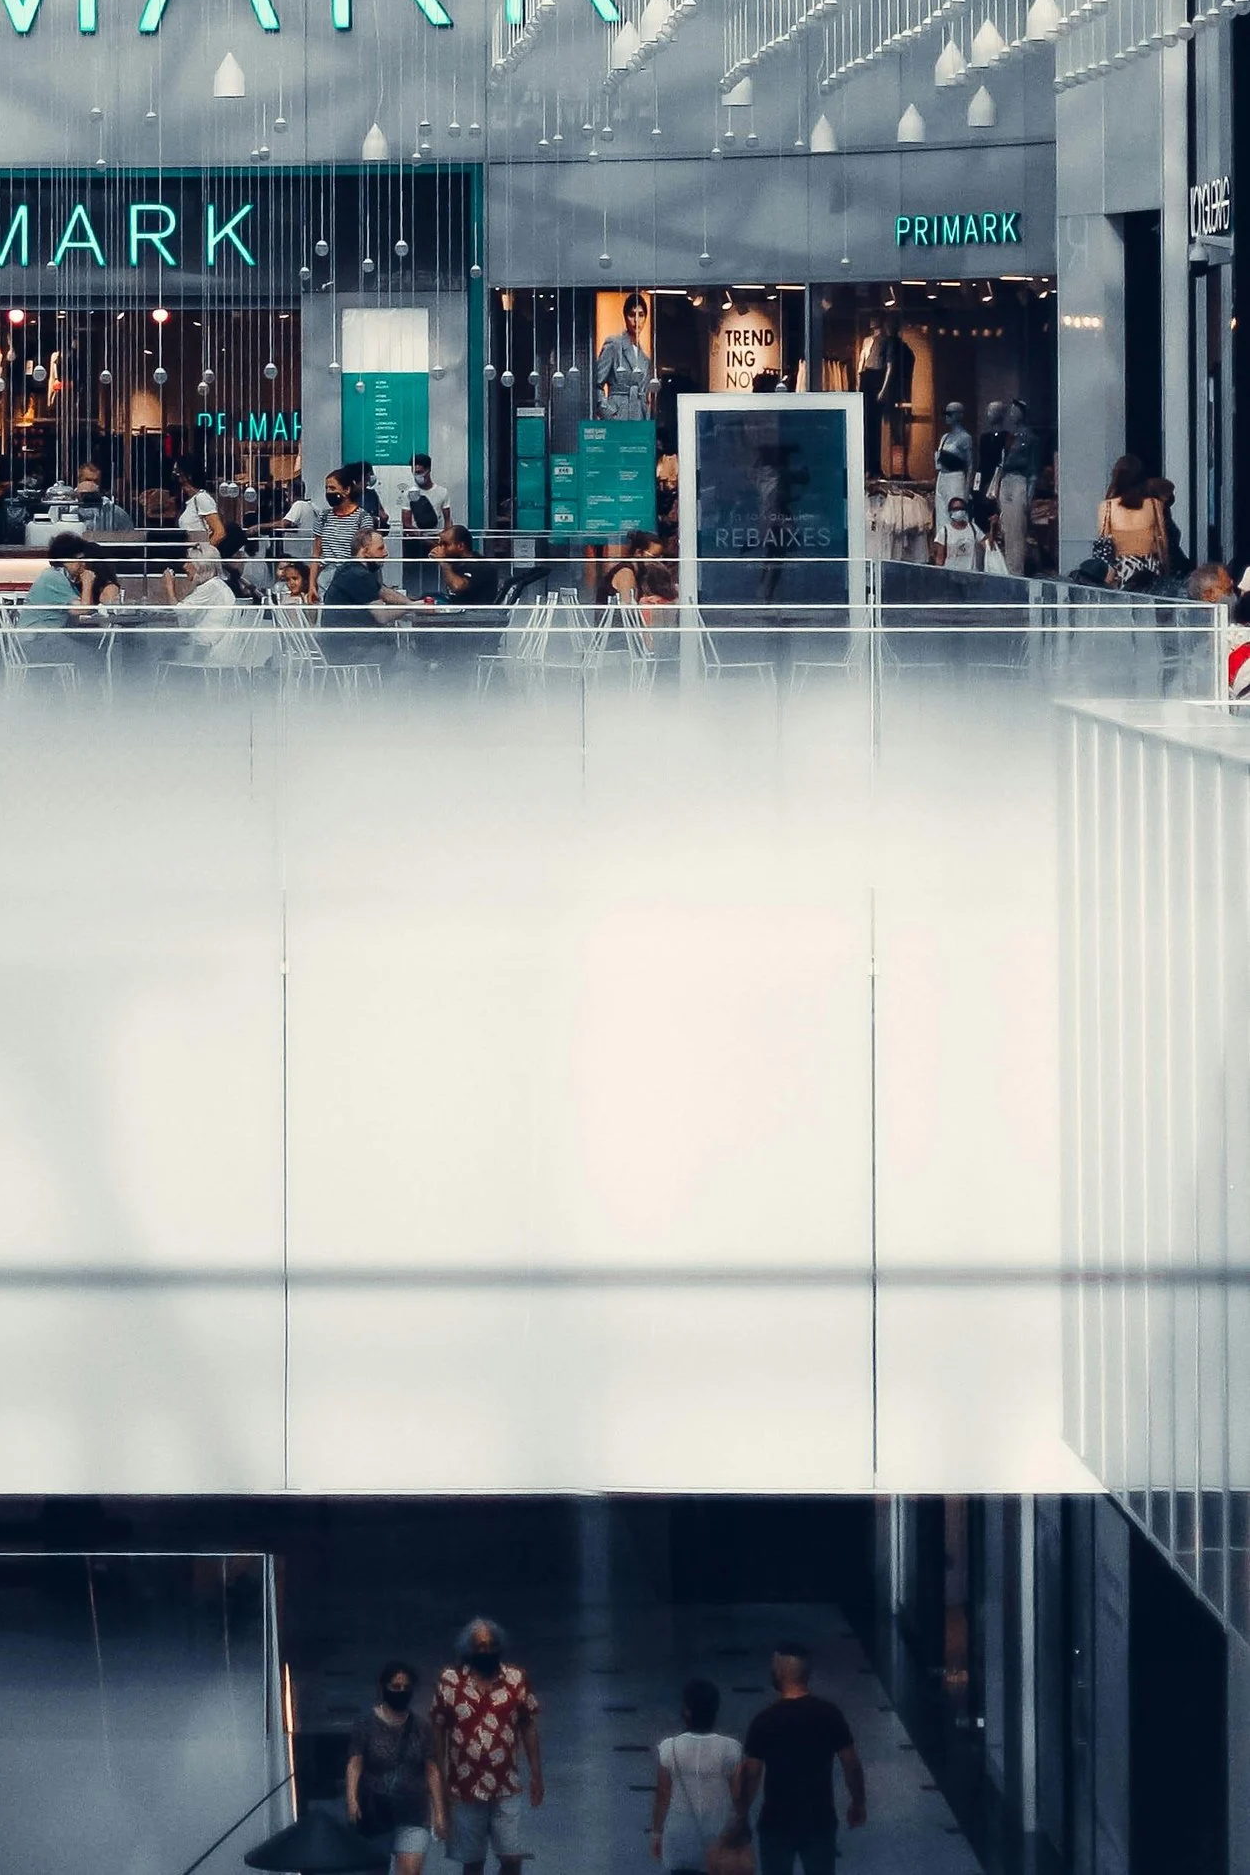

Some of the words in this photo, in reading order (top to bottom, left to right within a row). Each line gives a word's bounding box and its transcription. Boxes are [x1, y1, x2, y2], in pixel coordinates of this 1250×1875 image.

[896, 211, 1018, 245] PRIMARK
[725, 329, 774, 346] TREND
[726, 350, 756, 367] ING
[726, 371, 754, 389] NO
[715, 527, 831, 548] REBAIXES
